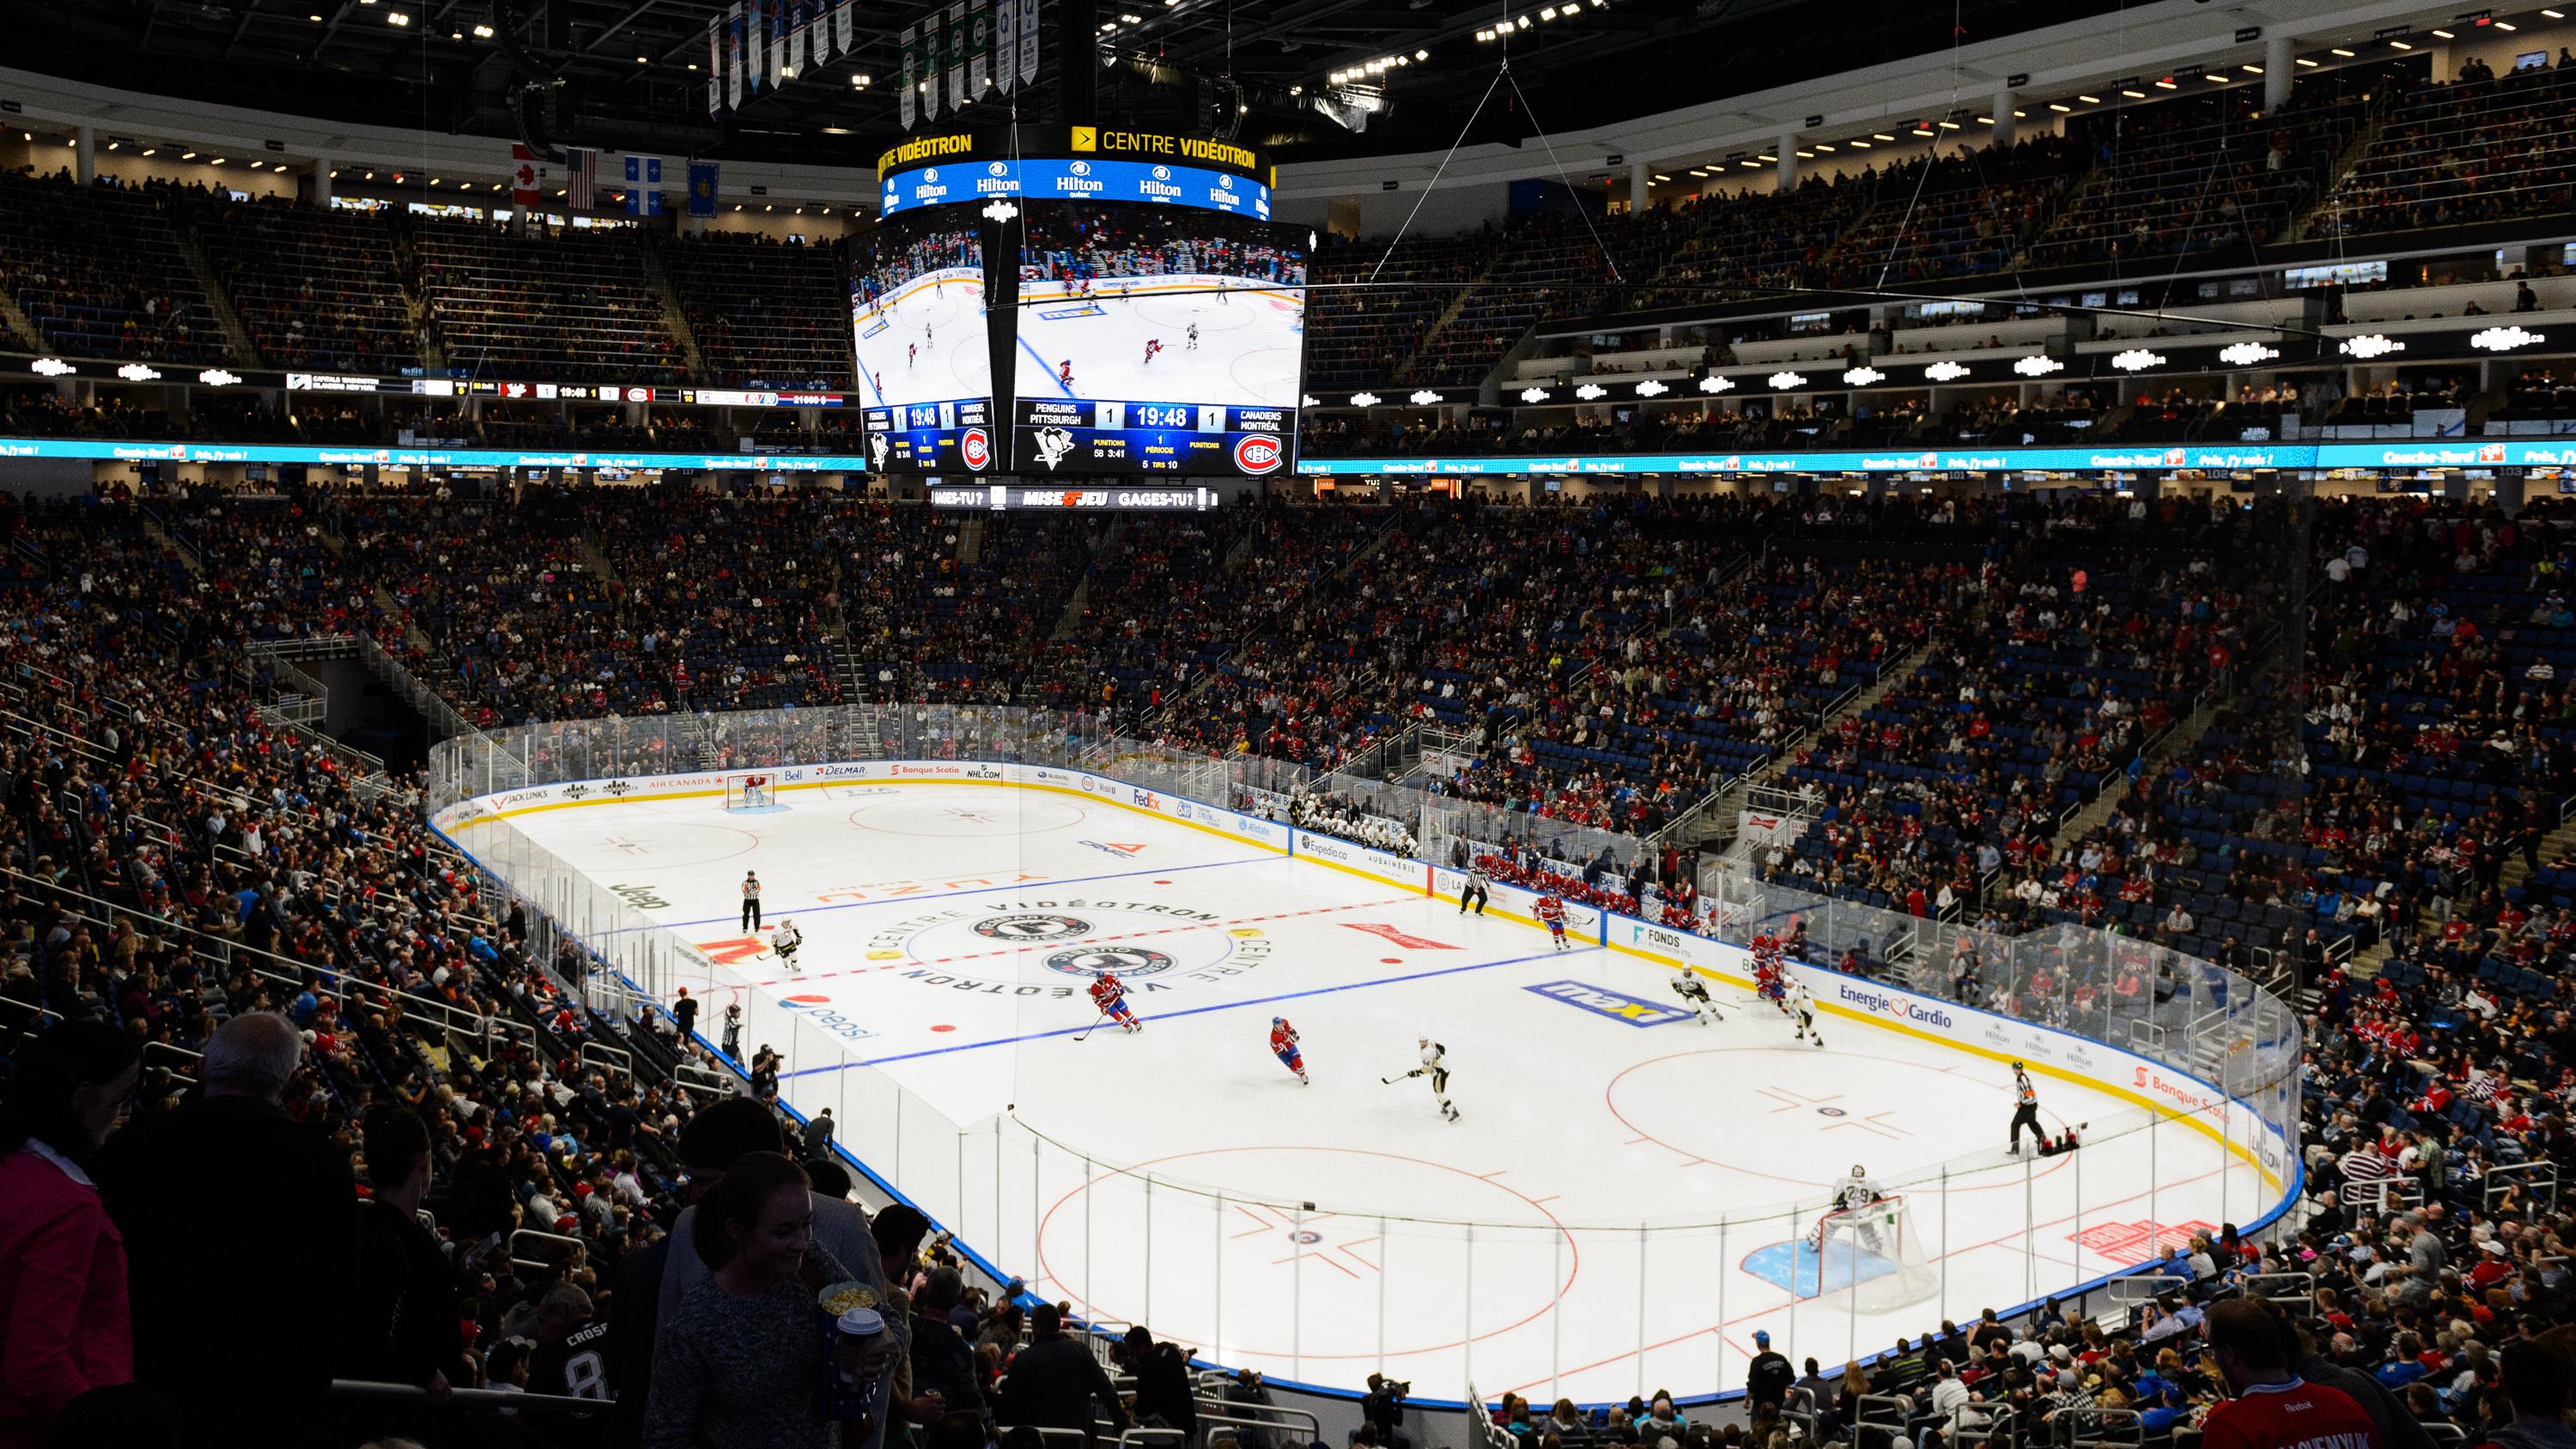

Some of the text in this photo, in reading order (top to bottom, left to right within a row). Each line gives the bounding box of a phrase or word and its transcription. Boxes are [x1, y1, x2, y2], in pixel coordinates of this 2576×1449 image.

[897, 135, 972, 163] VIDÉOTRON
[1103, 131, 1255, 169] CENTRE VIDÉOTRON
[977, 178, 1019, 192] Hilton
[1057, 177, 1103, 191] Hilton
[1139, 179, 1182, 197] Hilton
[916, 185, 947, 199] Hilton
[1210, 188, 1240, 206] Hilton
[560, 387, 597, 398] 19:48 1
[745, 394, 777, 404] 50/50
[1036, 403, 1077, 414] PENGUINS
[1106, 408, 1113, 423] 1
[1240, 411, 1282, 421] CANADIENS
[911, 407, 936, 427] 19:48
[1030, 415, 1082, 425] PITTSBURGH
[1137, 406, 1187, 427] 19:48
[1208, 412, 1214, 427] 1
[1241, 421, 1280, 432] MONTRÉAL
[1093, 449, 1125, 458] 58 3:41
[1145, 445, 1174, 454] PÉRIODE
[1142, 460, 1149, 469] 5
[1168, 460, 1178, 469] 10
[1948, 470, 1965, 479] 101
[2206, 470, 2228, 479] 102
[1023, 490, 1065, 506] MISE
[1075, 491, 1108, 506] JEU
[785, 770, 802, 781] Bell
[825, 766, 866, 775] DELMAR
[902, 766, 959, 775] Banque Scotia
[967, 770, 1000, 779] NHL.COM
[649, 778, 711, 789] AIR CANADA
[507, 794, 524, 804] JACK
[1134, 788, 1160, 811] FedEx
[1310, 840, 1347, 860] Expedia.ca
[1368, 855, 1416, 873] AUBAINERIE
[1451, 879, 1461, 891] LA
[1601, 874, 1614, 887] Bell
[609, 883, 672, 910] Jeep
[868, 898, 1219, 949] CENTRE VIDÉOTRON
[1648, 929, 1680, 948] FONDS
[1187, 938, 1272, 983] CENTRE
[1540, 984, 1686, 1023] maxi
[1840, 985, 1952, 1028] Energie Cardio
[799, 1009, 882, 1040] pepsi
[1985, 1029, 2011, 1044] Hilton
[2025, 1040, 2050, 1055] Hilton
[2067, 1052, 2093, 1069] Hilton
[2153, 1076, 2231, 1125] Banque Scotia
[1846, 1185, 1868, 1203] 29
[2284, 1401, 2313, 1412] Reebok
